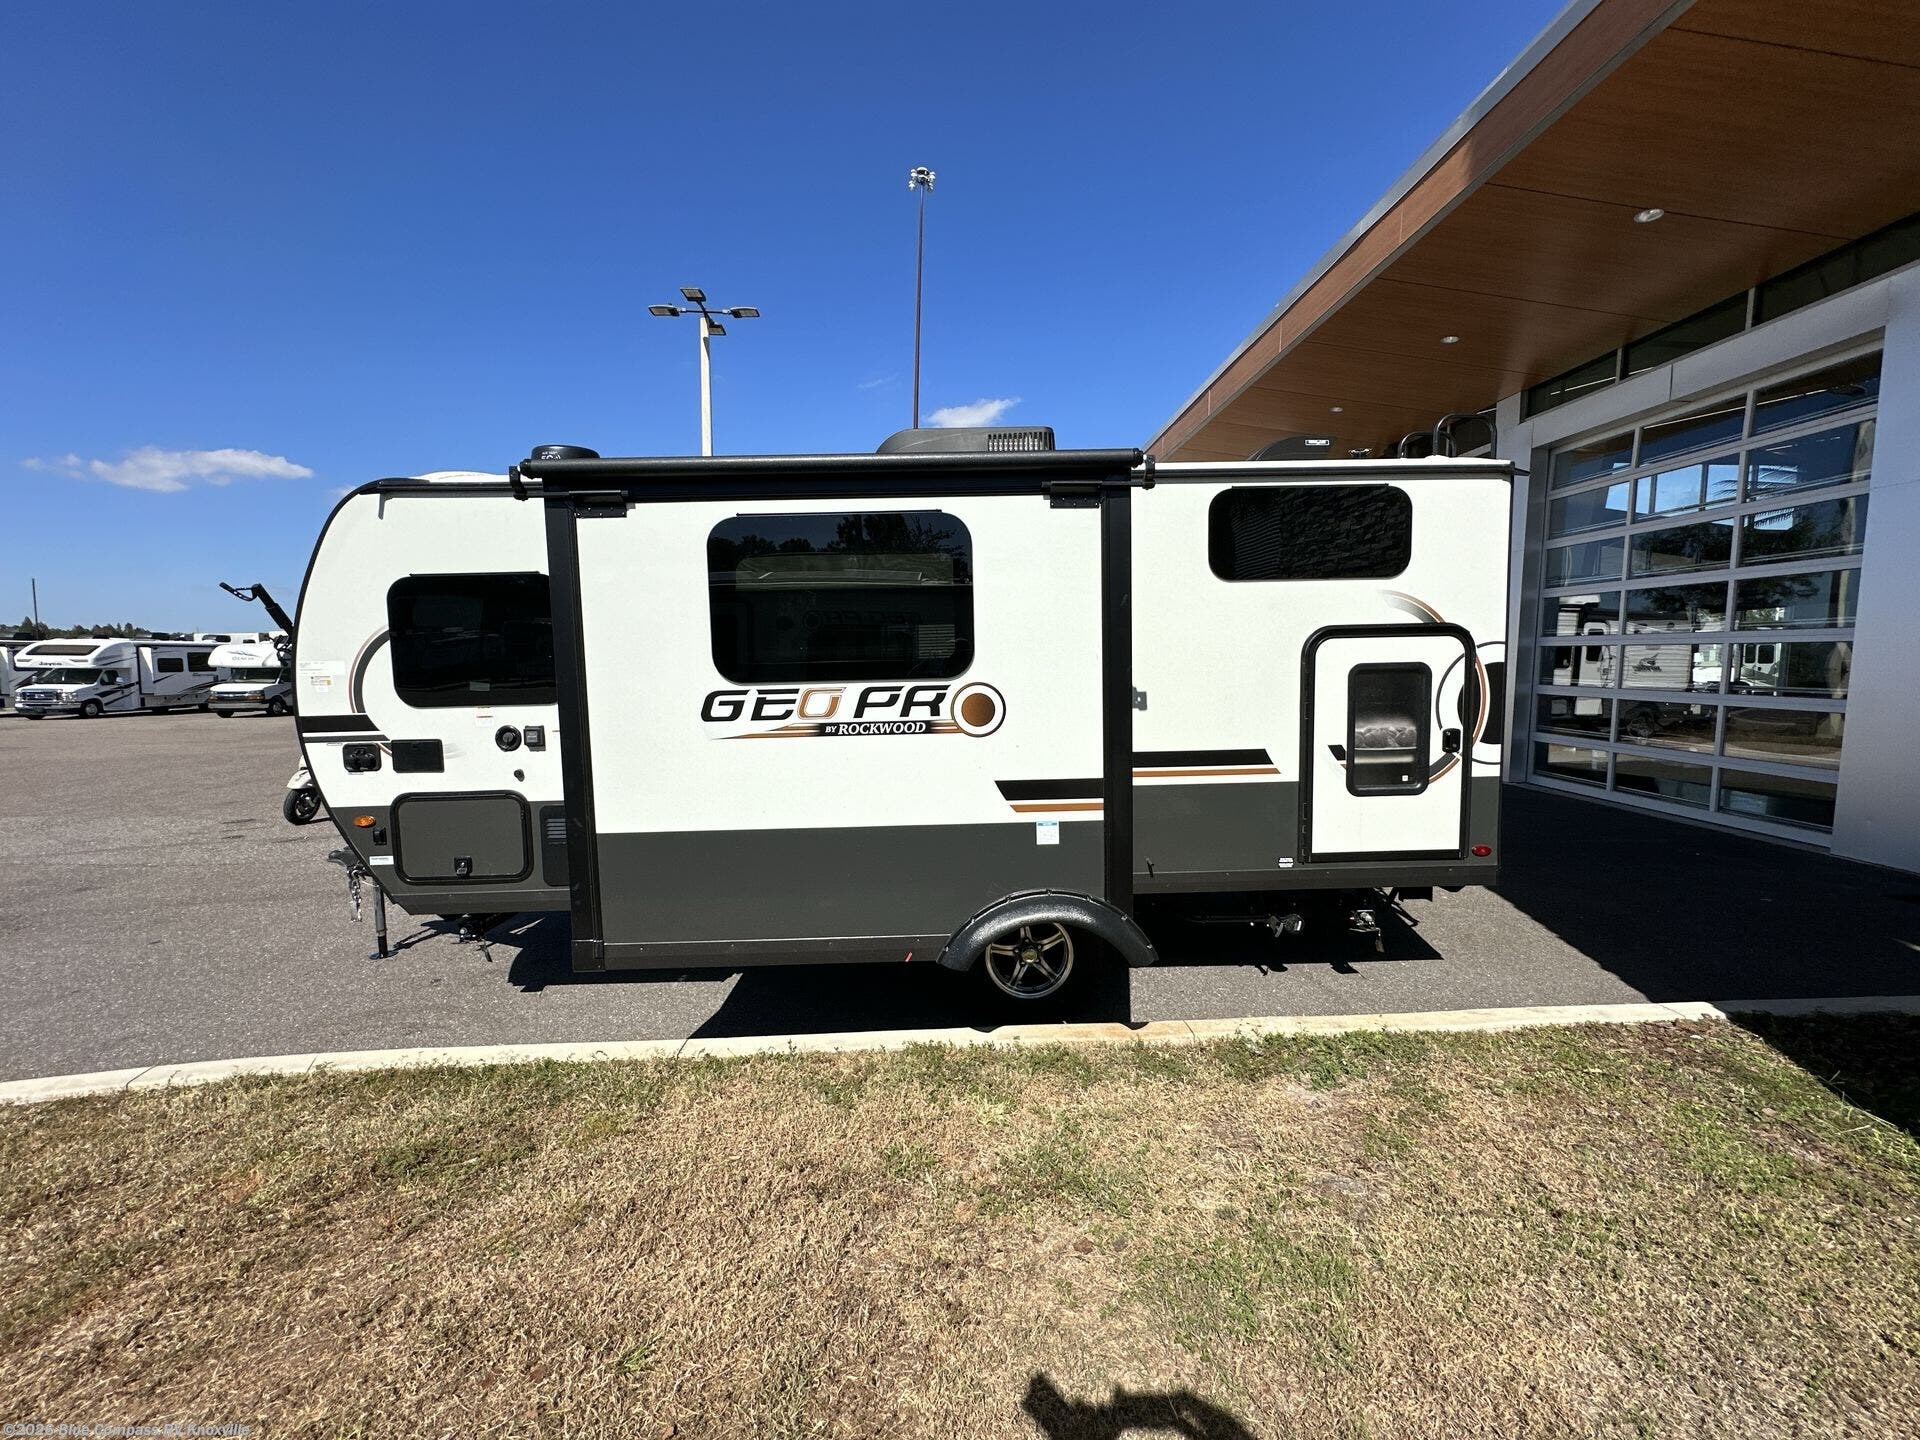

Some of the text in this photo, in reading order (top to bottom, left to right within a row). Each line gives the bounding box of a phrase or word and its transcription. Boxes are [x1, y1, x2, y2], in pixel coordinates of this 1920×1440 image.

[700, 686, 847, 722] GEO
[824, 720, 927, 736] BY ROCKWOOD
